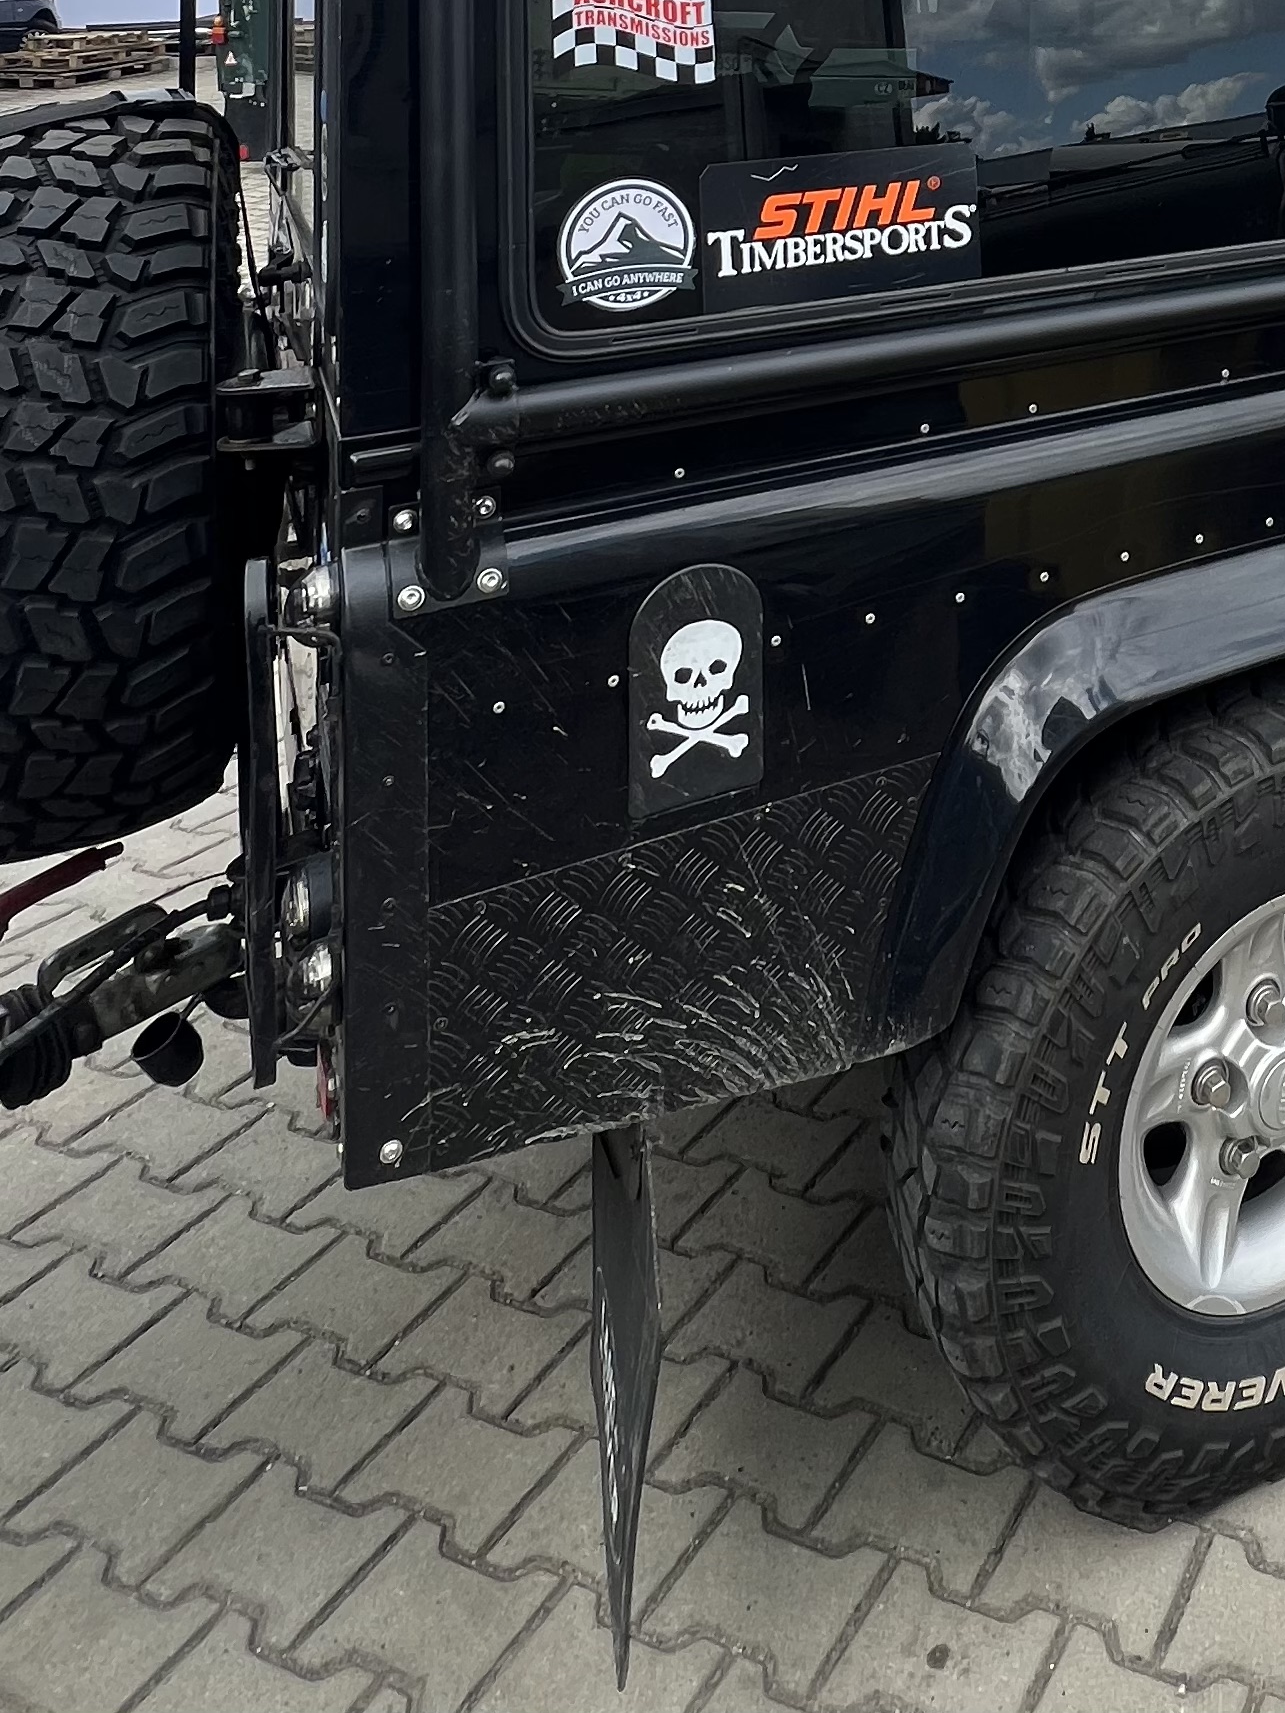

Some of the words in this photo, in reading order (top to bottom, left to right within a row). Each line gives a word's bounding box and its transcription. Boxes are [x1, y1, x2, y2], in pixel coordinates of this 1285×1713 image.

[574, 9, 711, 47] TRANSMISSIONS
[578, 207, 601, 234] YOU
[601, 193, 630, 211] CAN
[633, 193, 653, 207] GO
[652, 200, 679, 228] FAST
[752, 179, 936, 240] STIHL
[707, 204, 974, 278] TIMBERSPORTS
[571, 285, 578, 297] I
[578, 278, 603, 294] CAN
[604, 275, 620, 288] GO
[621, 272, 684, 286] ANYWHERE
[1078, 1021, 1129, 1166] STT
[1141, 922, 1203, 1010] PRO
